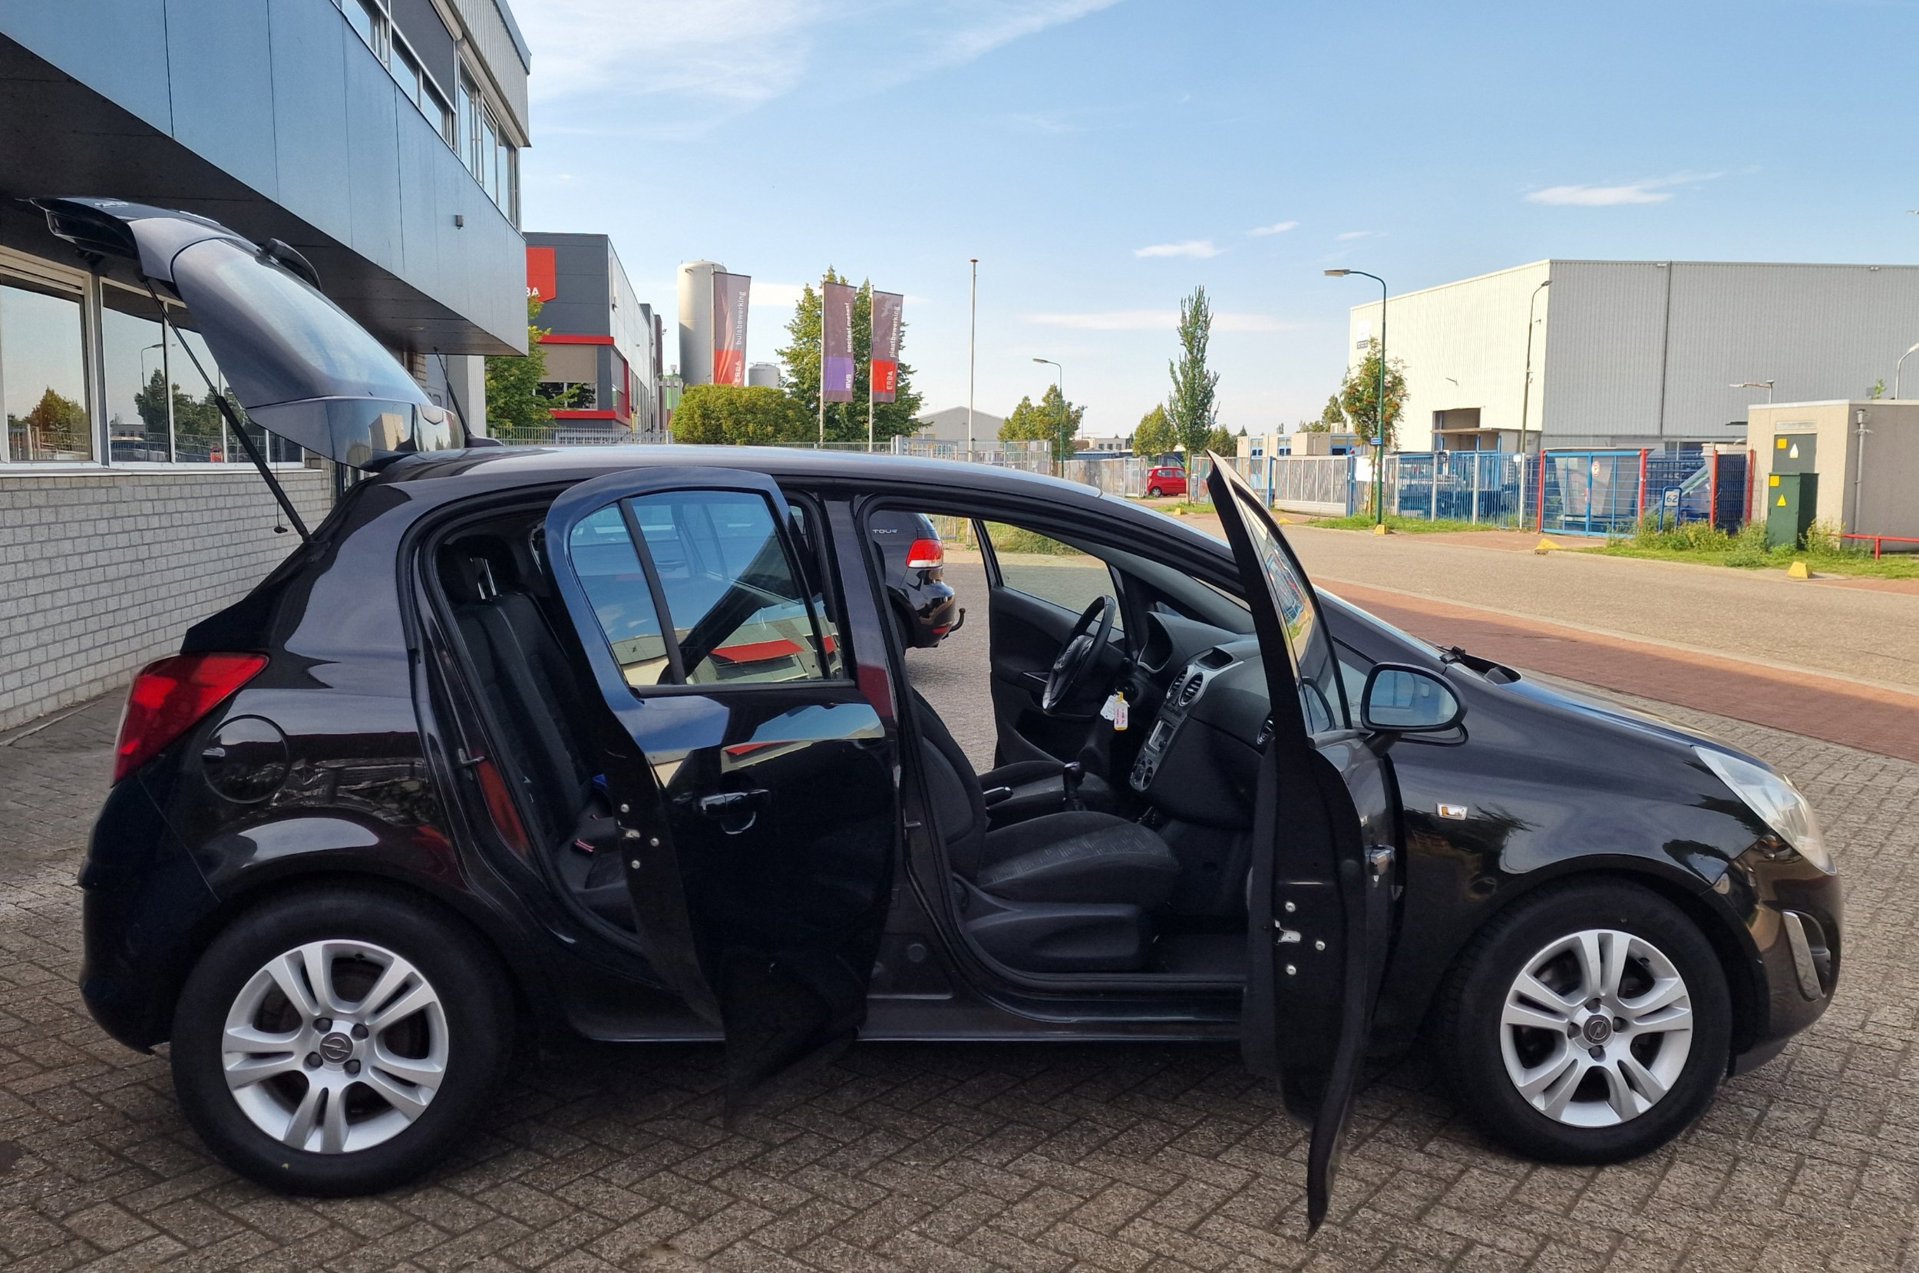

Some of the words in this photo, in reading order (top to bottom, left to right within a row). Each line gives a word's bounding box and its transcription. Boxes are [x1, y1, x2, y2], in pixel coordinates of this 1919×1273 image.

[889, 305, 901, 358] plaatbewerking
[886, 370, 894, 391] ERBA
[1666, 494, 1678, 503] 62
